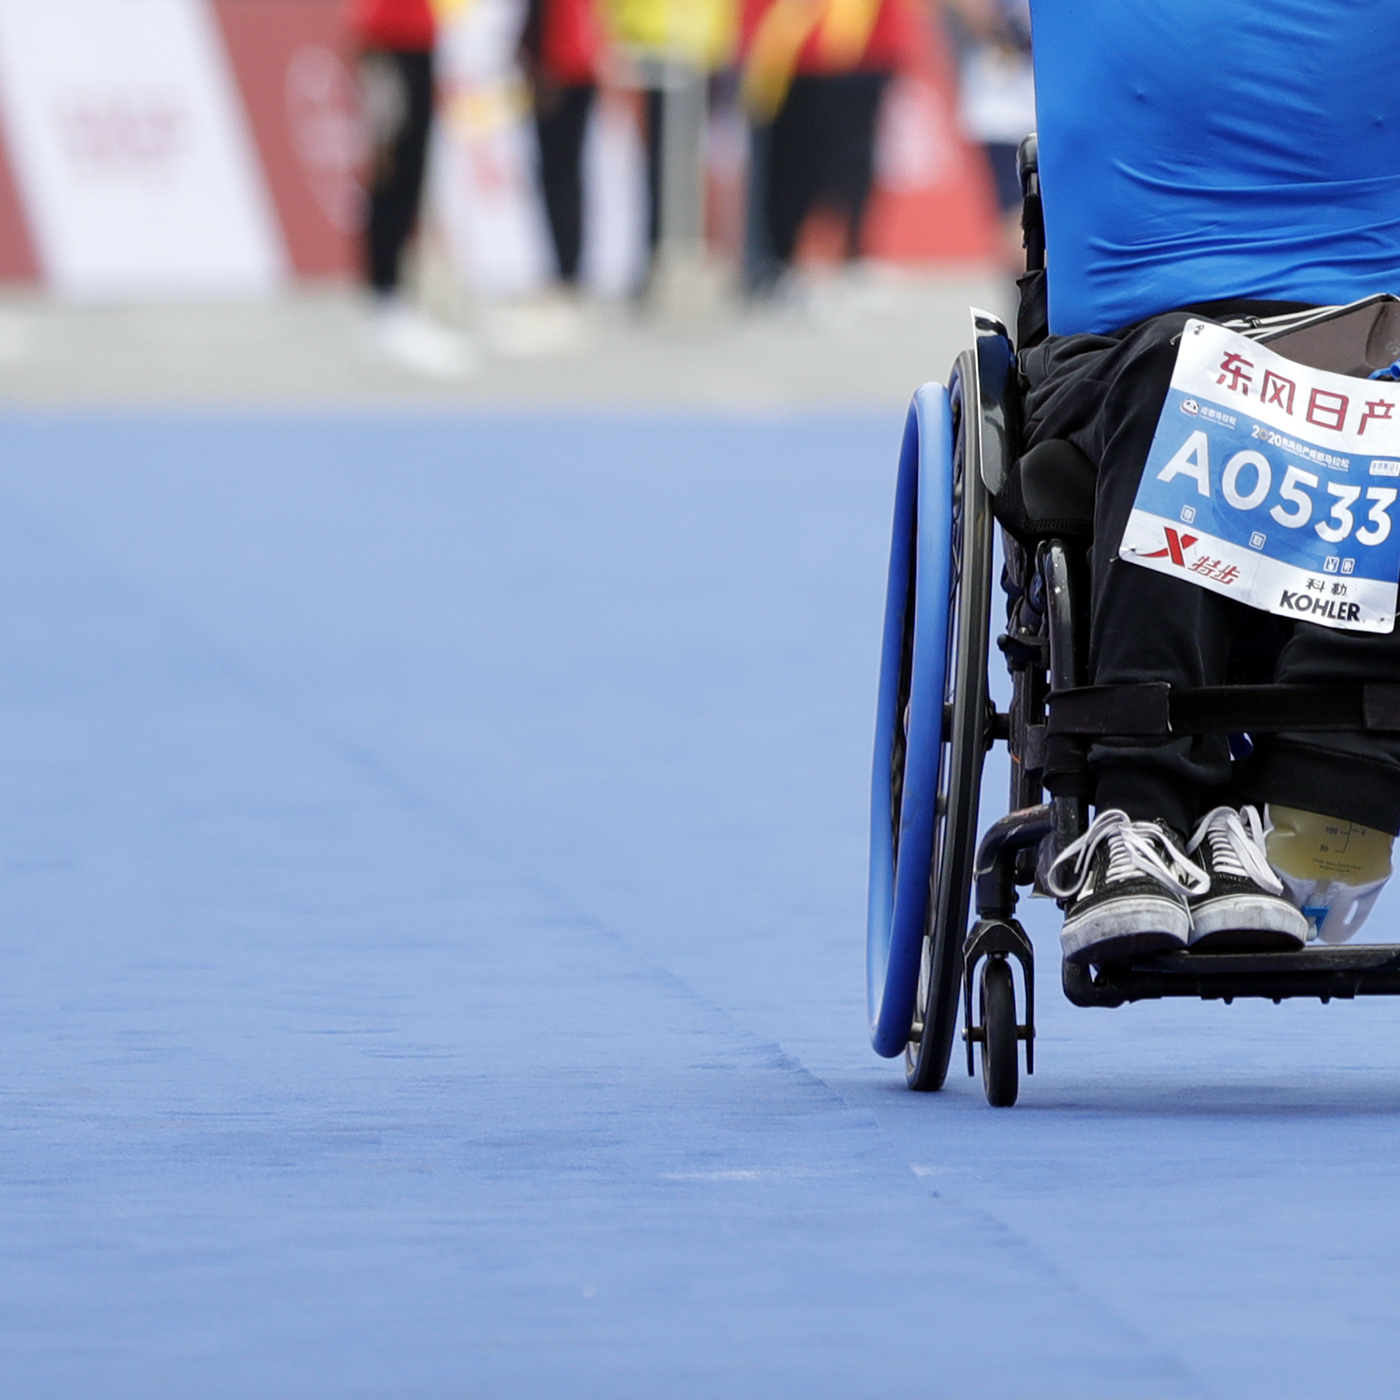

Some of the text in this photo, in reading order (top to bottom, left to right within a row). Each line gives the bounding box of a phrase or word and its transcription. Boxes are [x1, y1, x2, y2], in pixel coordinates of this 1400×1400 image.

[1215, 351, 1396, 436] 东风日产
[1156, 429, 1398, 547] A0533
[1187, 555, 1241, 585] 特步
[1279, 589, 1361, 622] KOHLER
